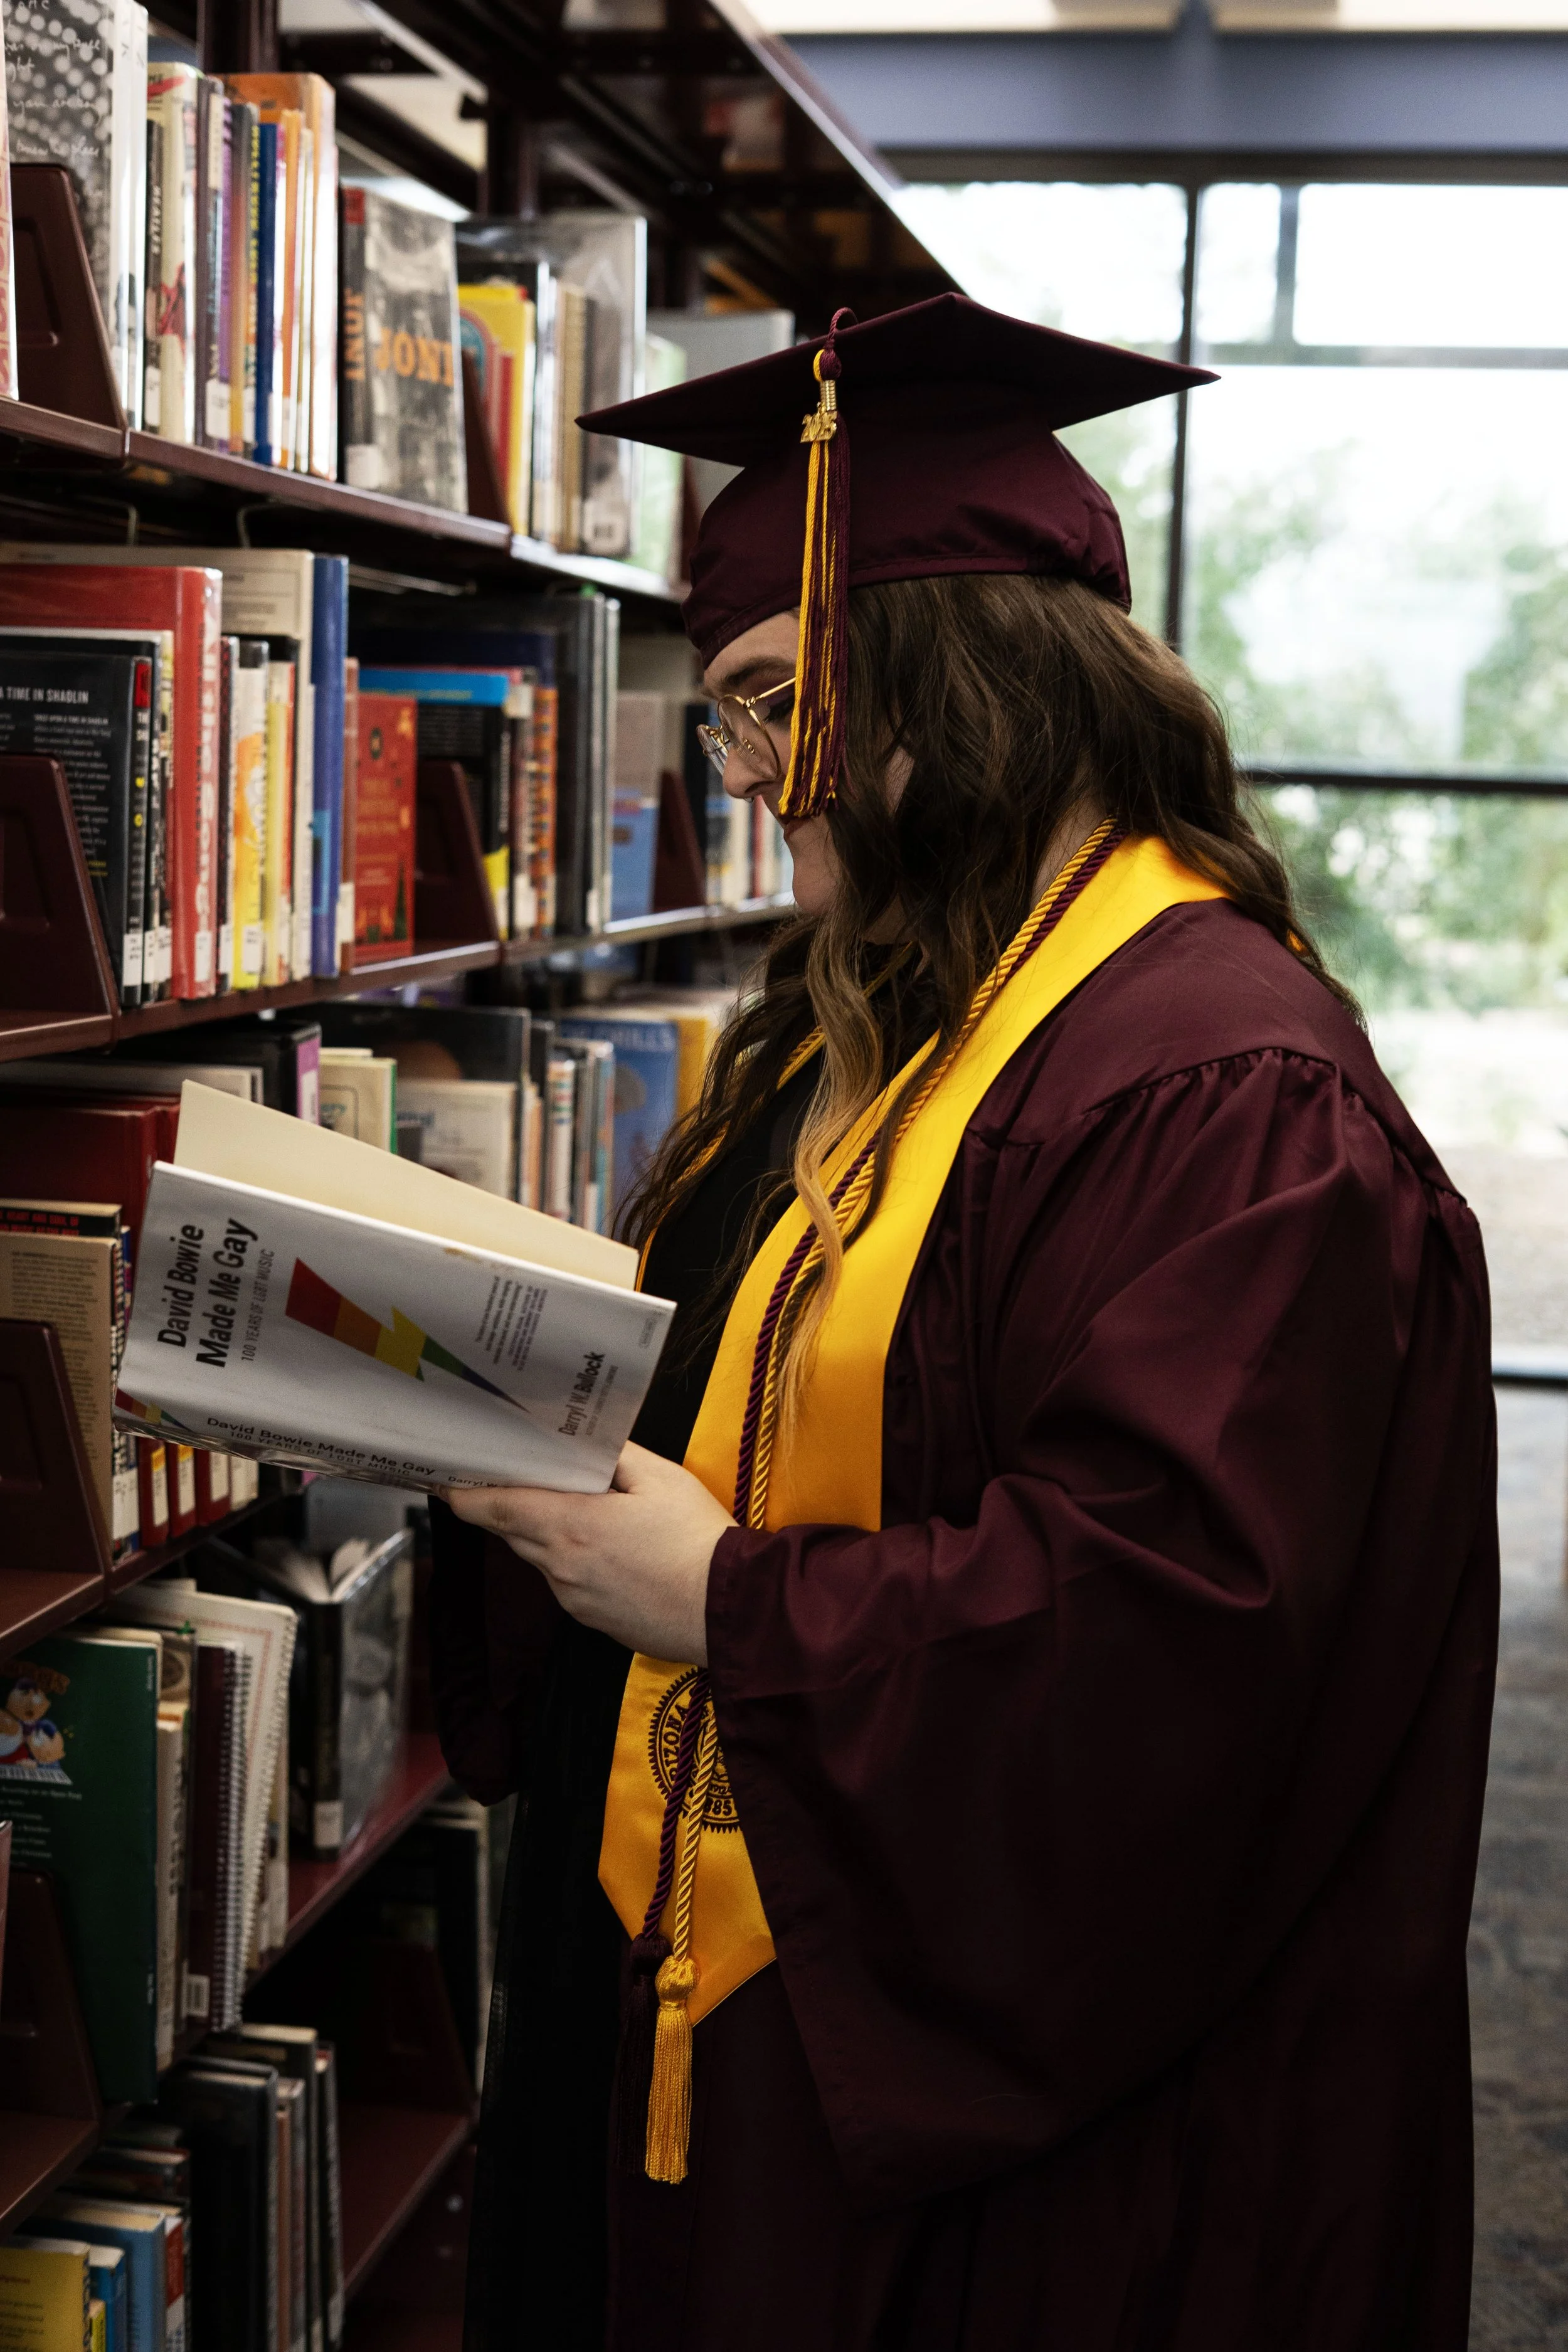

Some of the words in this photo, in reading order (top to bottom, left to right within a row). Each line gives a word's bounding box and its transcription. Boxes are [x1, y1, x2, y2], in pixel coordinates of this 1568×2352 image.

[7, 686, 31, 701] TIME
[33, 687, 45, 702] IN
[46, 688, 89, 704] SHAOLIN
[167, 1224, 204, 1286] Bowie
[212, 1217, 258, 1269] Gay
[256, 1248, 275, 1280] MUSIC
[208, 1271, 242, 1303] Me
[157, 1285, 195, 1348] David
[195, 1303, 236, 1368] Made
[245, 1315, 263, 1342] YEARS
[241, 1343, 257, 1362] 100
[558, 1404, 588, 1436] Darryl
[573, 1351, 605, 1394] Bullock
[208, 1417, 255, 1435] David
[260, 1429, 312, 1448] Bowie
[318, 1443, 366, 1459] Made
[371, 1454, 397, 1466] Me
[402, 1462, 436, 1476] Gay
[231, 1431, 252, 1441] 100
[258, 1437, 301, 1453] YEARS
[329, 1453, 361, 1465] LGBT
[368, 1462, 411, 1474] MUSIC
[448, 1476, 484, 1486] Darryl
